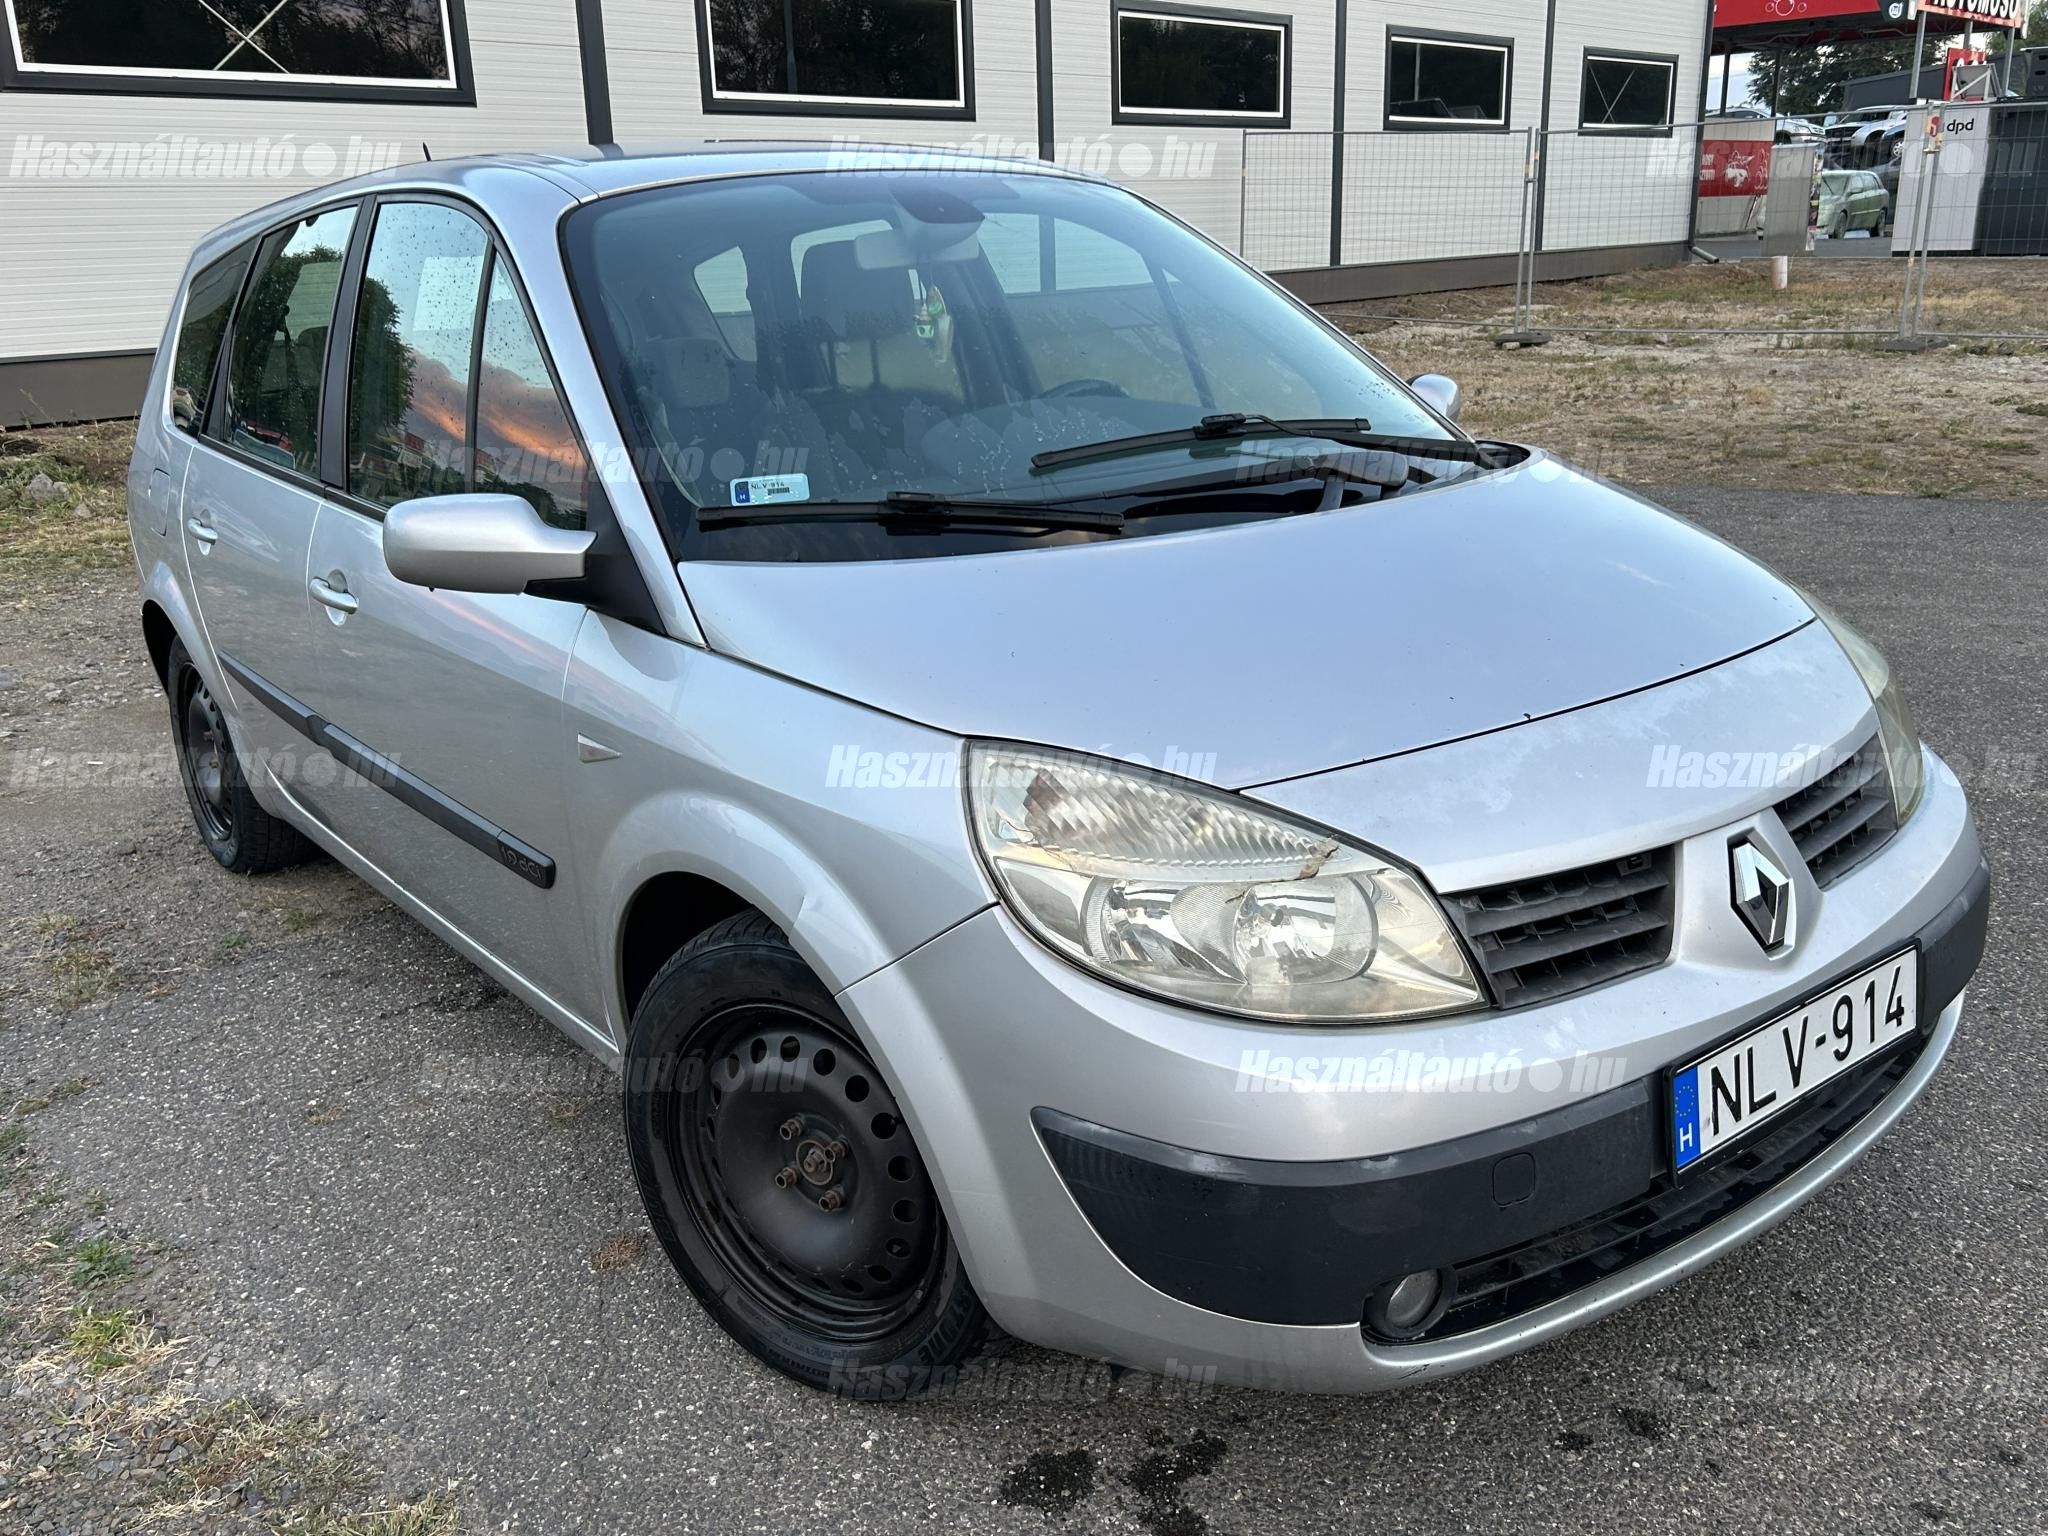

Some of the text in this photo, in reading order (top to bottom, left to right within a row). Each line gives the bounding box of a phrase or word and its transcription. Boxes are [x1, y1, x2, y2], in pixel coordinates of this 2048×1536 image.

[1946, 118, 1974, 134] dpd
[1710, 965, 1905, 1136] NLV-914
[1679, 1122, 1694, 1152] H
